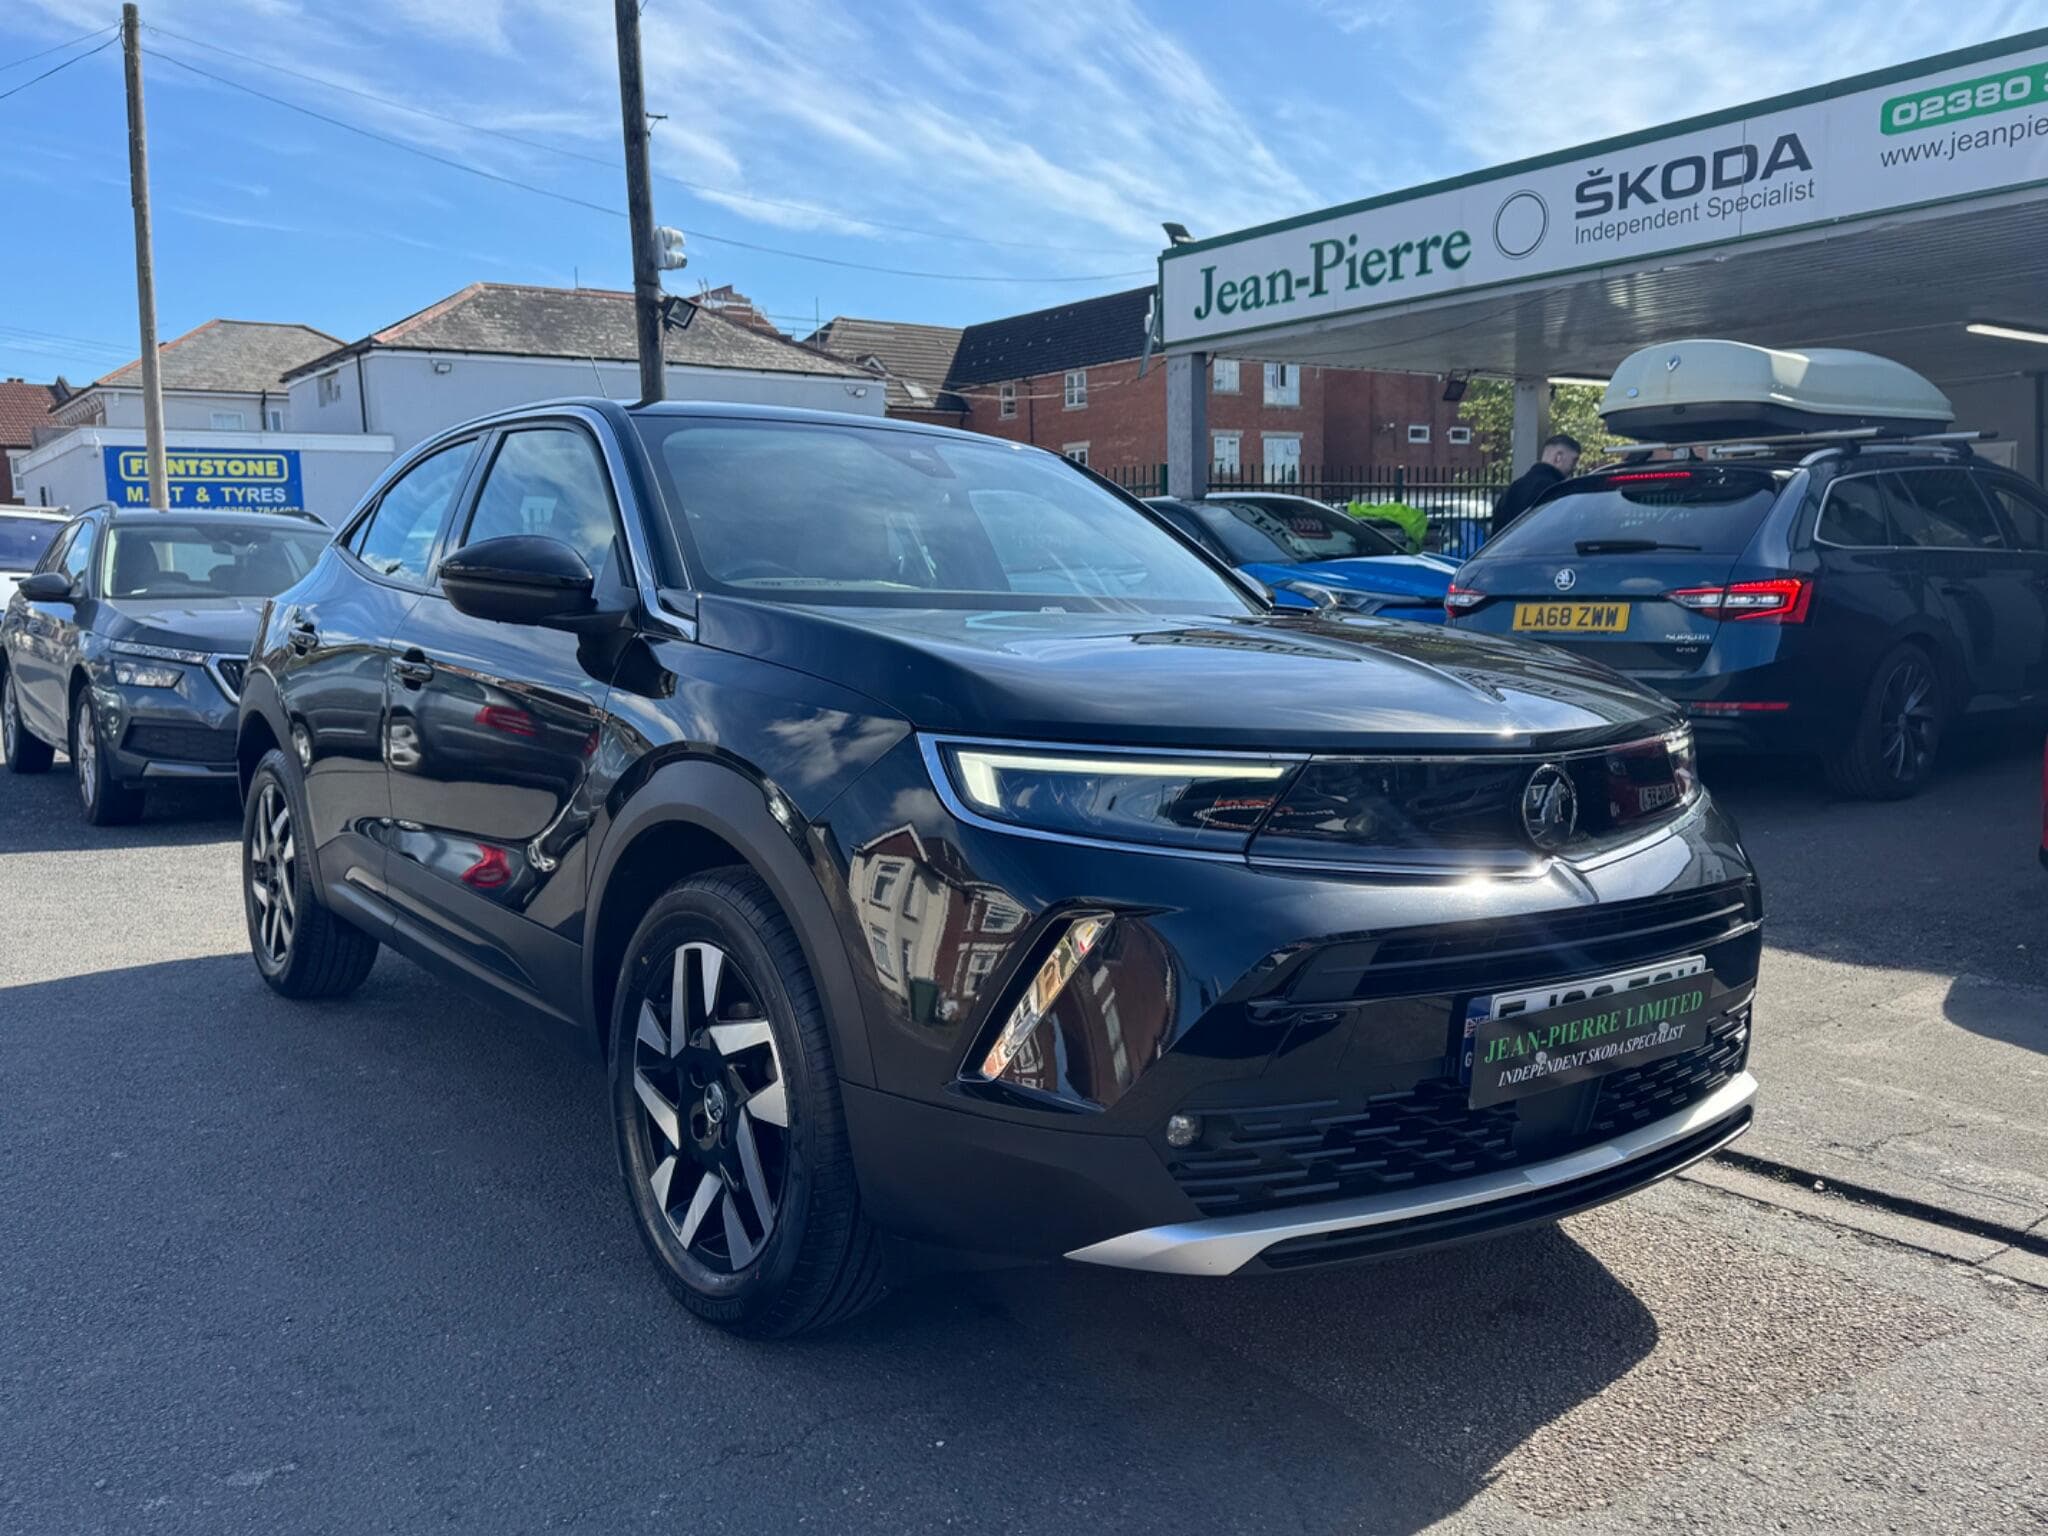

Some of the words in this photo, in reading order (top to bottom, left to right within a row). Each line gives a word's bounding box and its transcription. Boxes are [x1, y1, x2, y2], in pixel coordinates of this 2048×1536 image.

[1891, 75, 2032, 127] 02380
[1575, 133, 1813, 220] ŠKODA
[1575, 202, 1700, 244] Independent
[1706, 178, 1815, 220] Specialist
[1194, 229, 1471, 320] Jean-Pierre
[130, 457, 279, 477] FNTSTONE
[196, 487, 210, 503] &
[220, 487, 286, 503] TYRES
[1521, 606, 1572, 626] LA68
[1577, 606, 1618, 626] ZWW
[1484, 1009, 1621, 1064] JEAN-PIERRE
[1626, 990, 1704, 1028] LIMITED
[1497, 1051, 1588, 1087] INDEPENDENT
[1586, 1039, 1625, 1063] SKODA
[1624, 1024, 1686, 1052] SPECIALIST
